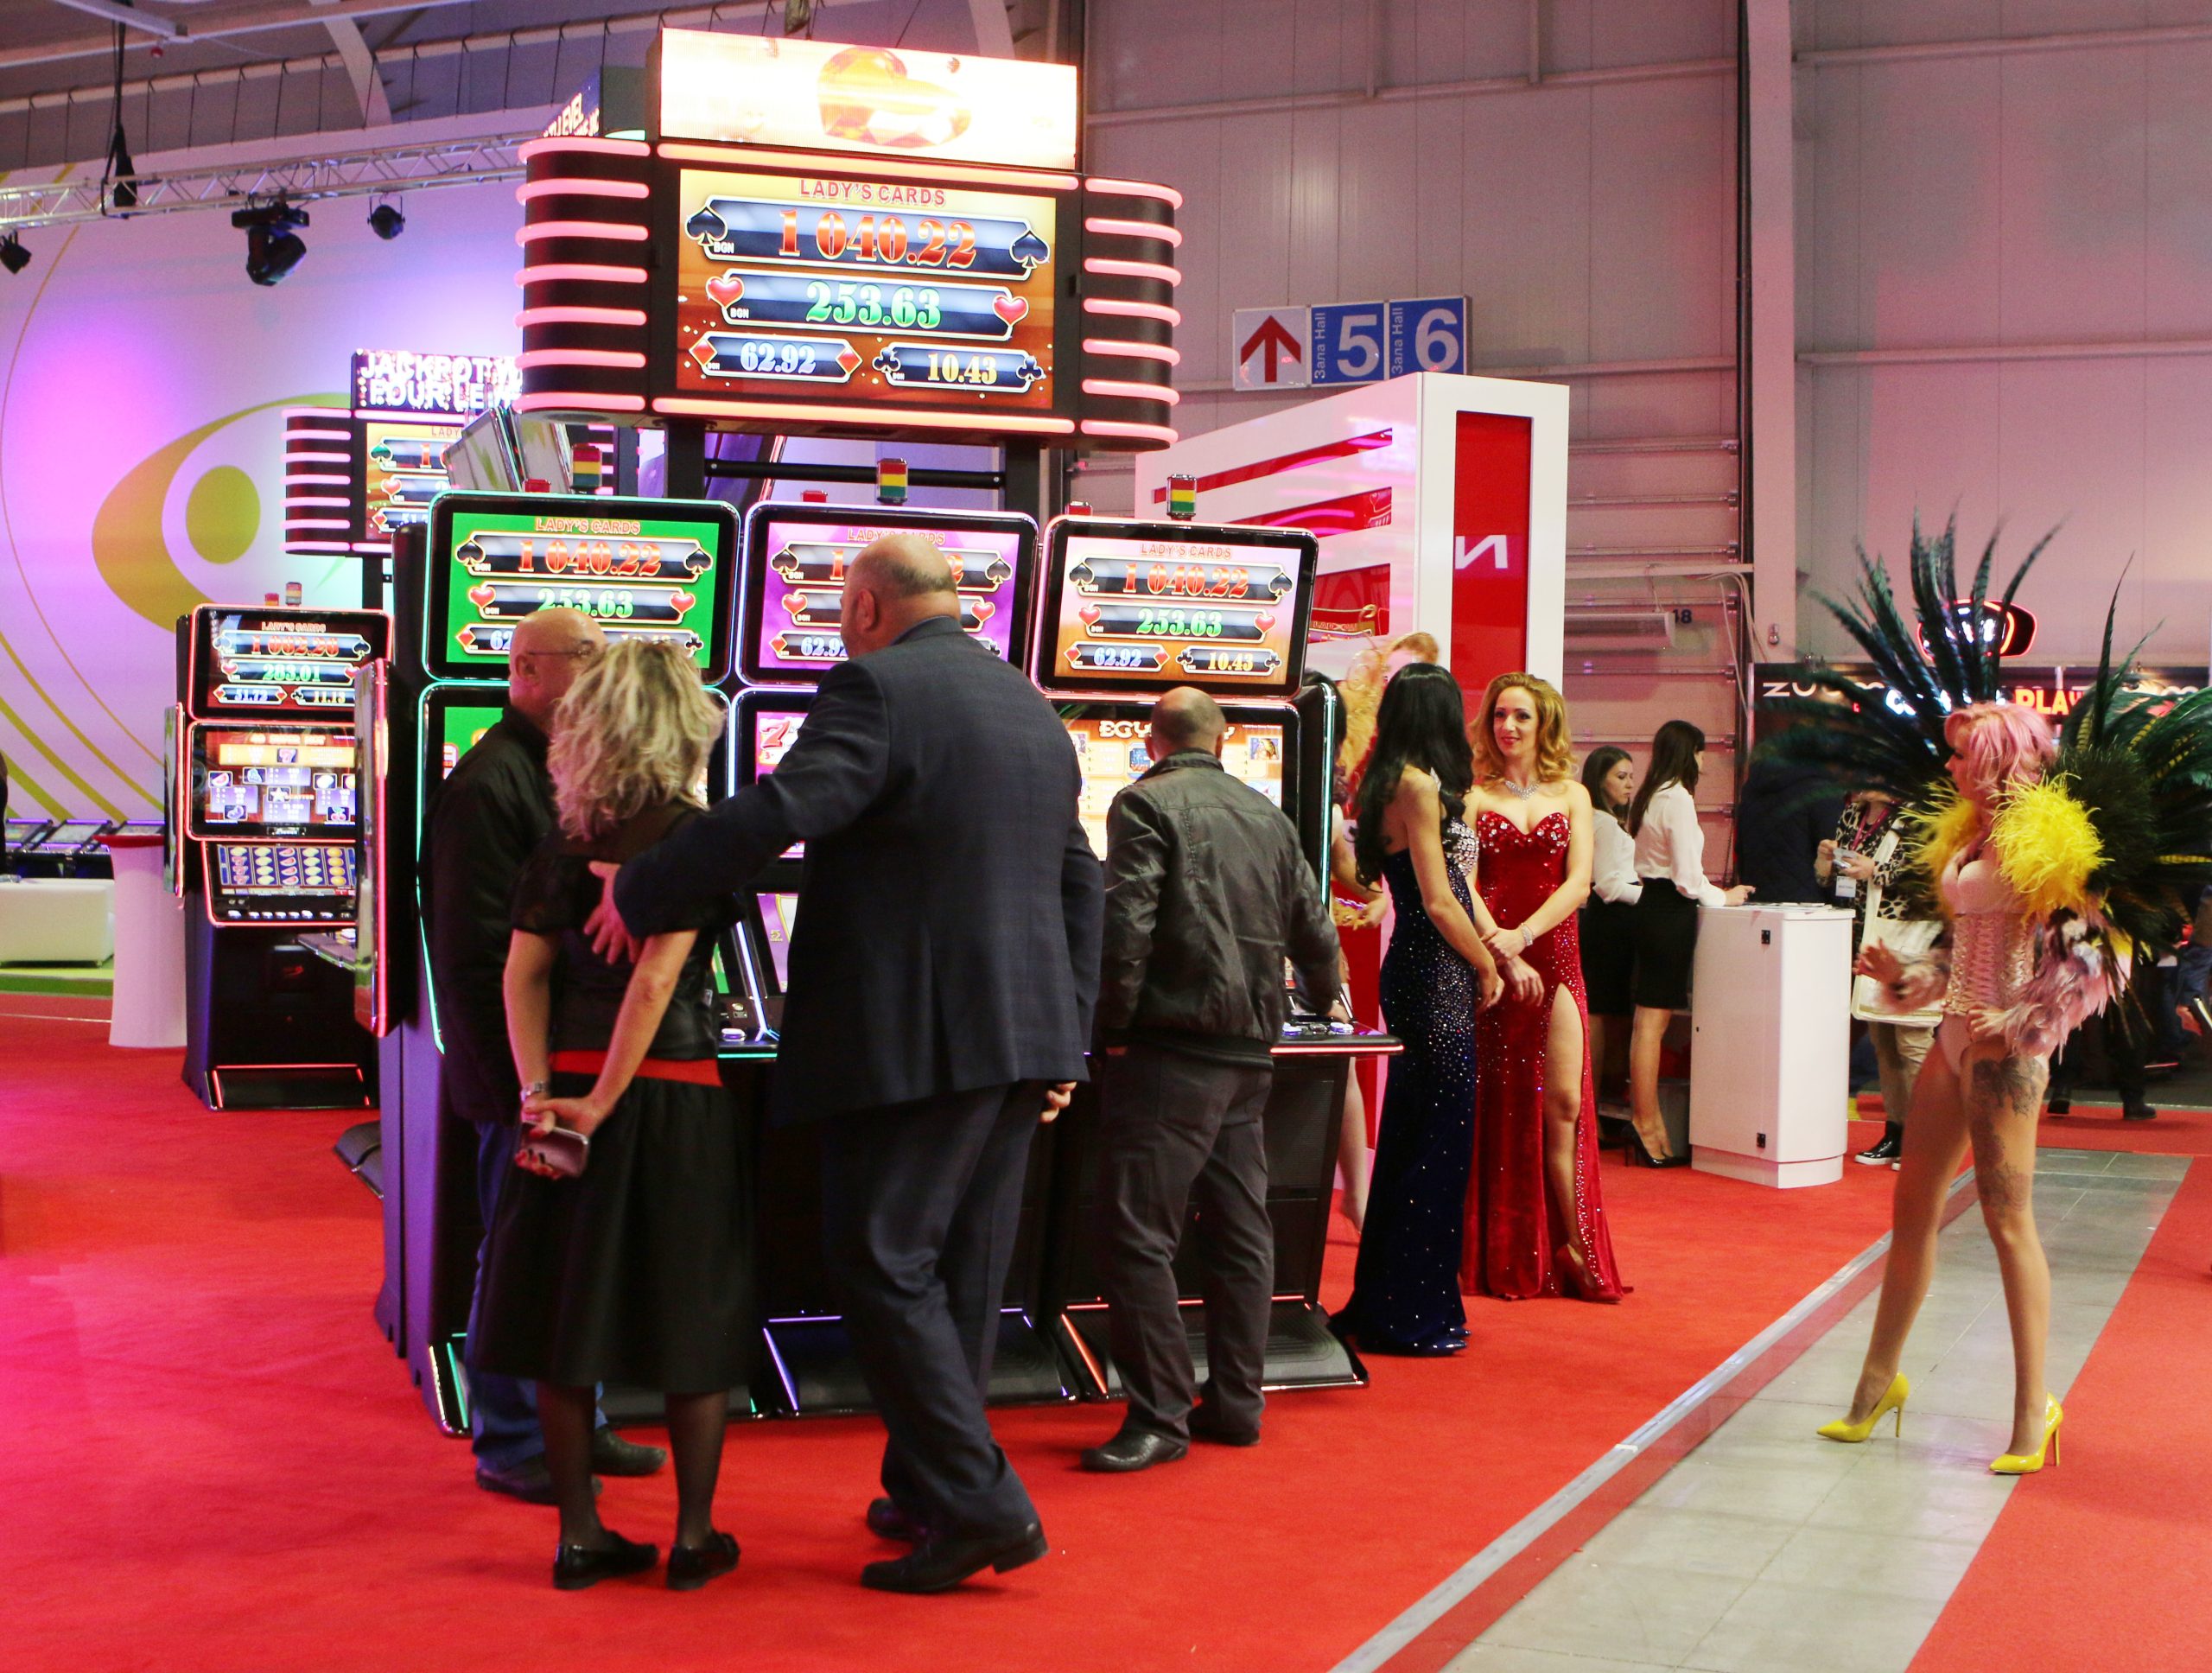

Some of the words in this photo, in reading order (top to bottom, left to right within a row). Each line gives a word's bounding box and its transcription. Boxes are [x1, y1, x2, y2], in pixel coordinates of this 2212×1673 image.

[799, 178, 873, 201] LADY'S
[877, 185, 946, 207] CARDS
[714, 241, 734, 254] BGN
[816, 210, 977, 269] 040.22
[805, 279, 941, 329] 253.63
[1315, 312, 1327, 340] Hall
[1390, 307, 1404, 334] Hall
[1337, 314, 1380, 378] 5
[1414, 308, 1459, 372] 6
[740, 341, 817, 374] 62.92
[927, 352, 998, 385] 10.43
[1314, 344, 1325, 378] Зала
[1390, 339, 1403, 374] Зала
[431, 427, 461, 436] LADY
[535, 517, 589, 533] LADY'S
[591, 519, 641, 536] CARDS
[545, 538, 662, 577] 040.22
[1141, 543, 1186, 557] LADY'S
[1189, 545, 1232, 561] CARDS
[1147, 563, 1249, 599] 040.22
[1135, 607, 1223, 638] 253.63
[1093, 646, 1142, 667] 62.92
[1207, 652, 1254, 672] 10.43
